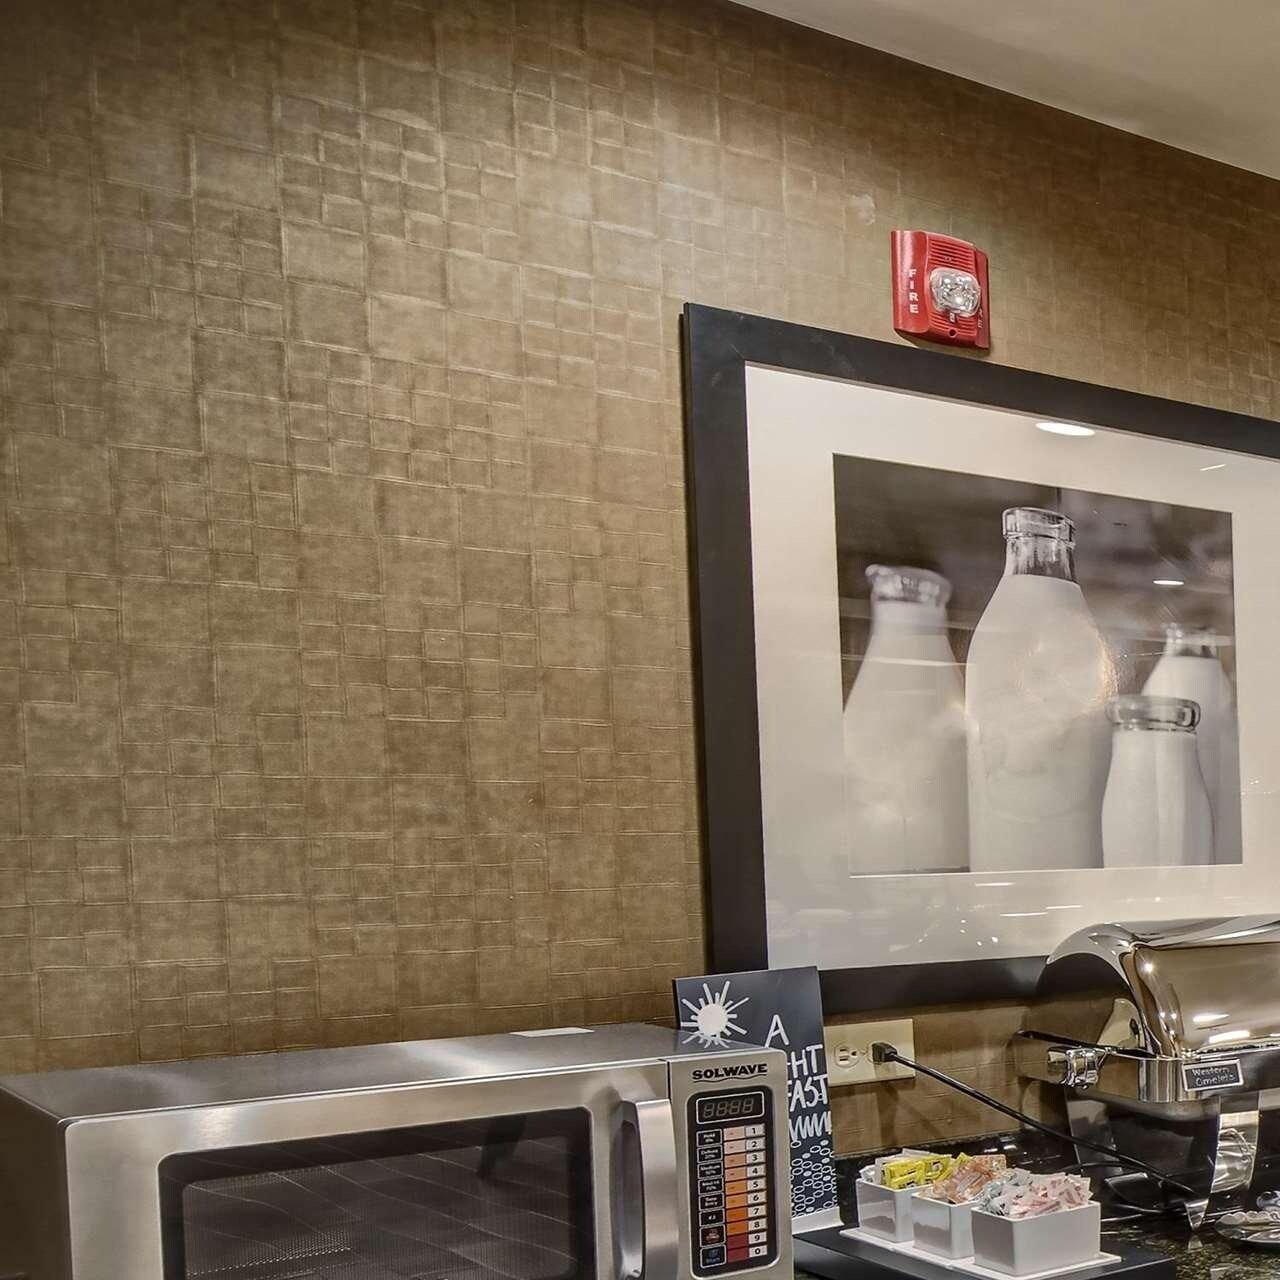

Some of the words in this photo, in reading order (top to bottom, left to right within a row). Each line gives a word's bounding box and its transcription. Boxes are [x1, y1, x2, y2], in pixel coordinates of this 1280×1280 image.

[908, 268, 919, 314] FIRE
[765, 1014, 789, 1048] A
[692, 1063, 768, 1081] SOLWAVE
